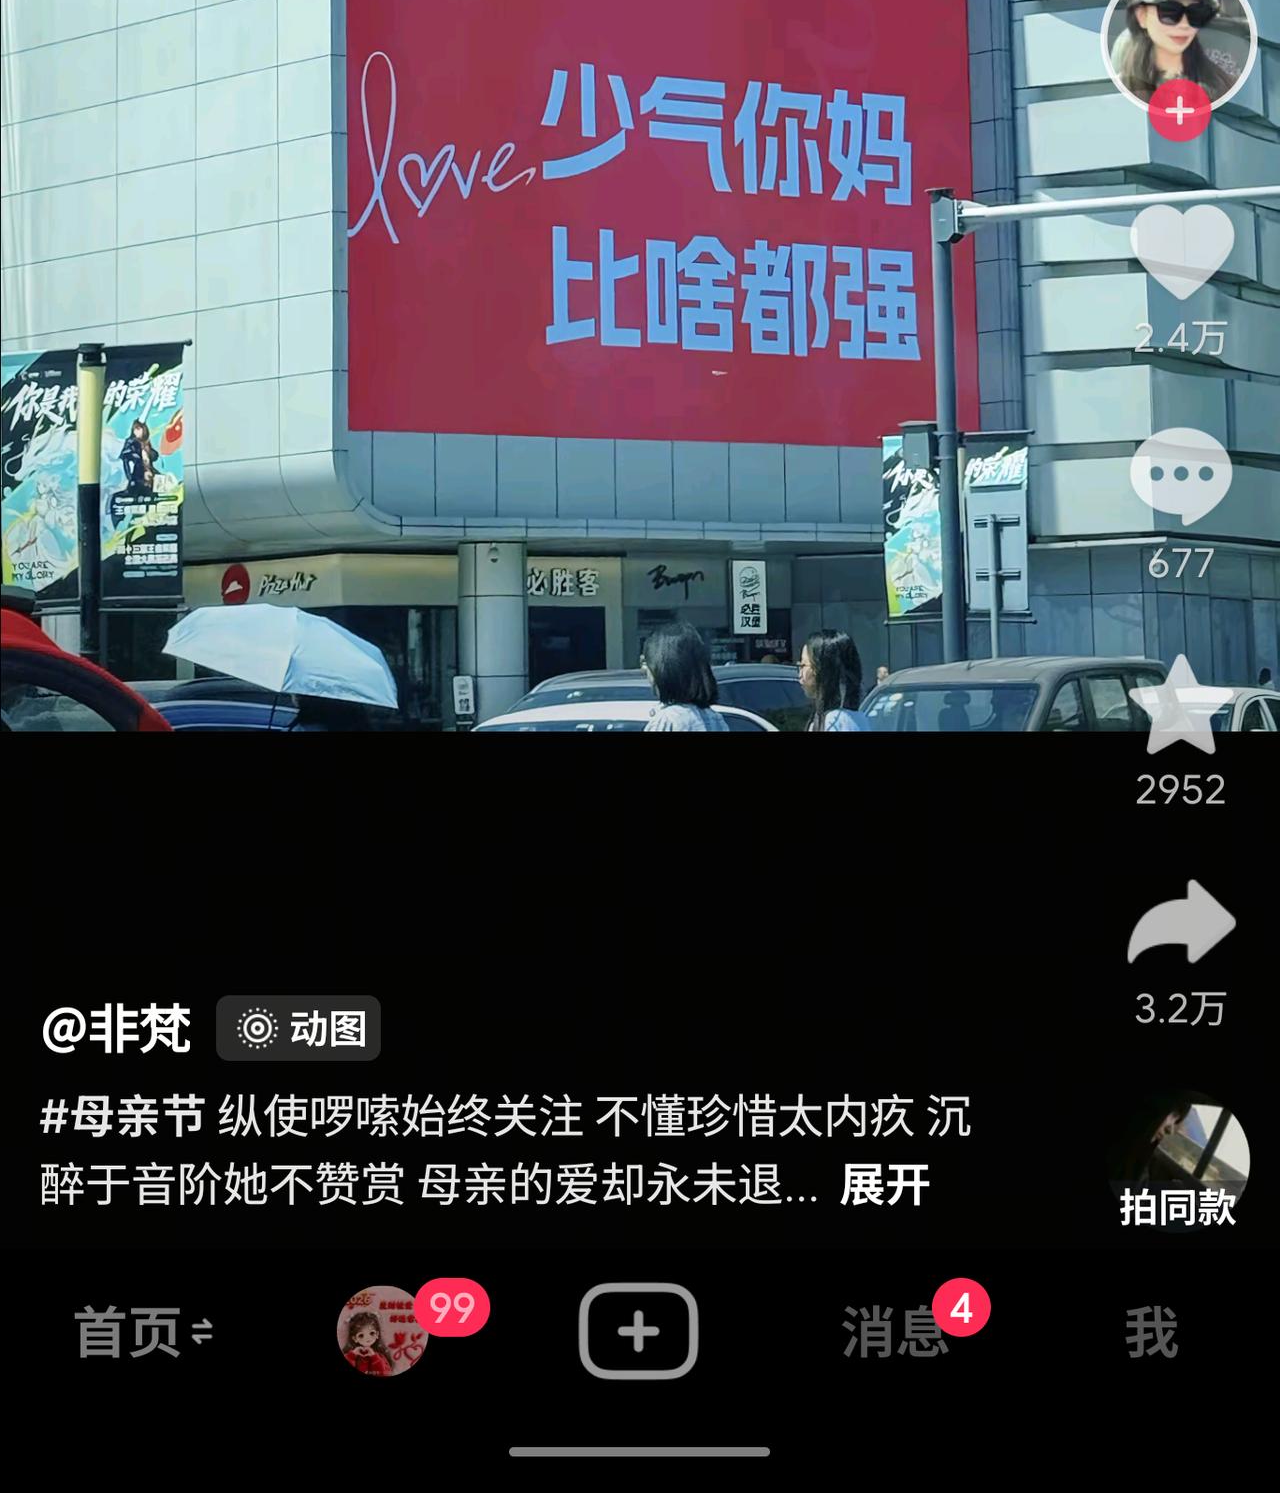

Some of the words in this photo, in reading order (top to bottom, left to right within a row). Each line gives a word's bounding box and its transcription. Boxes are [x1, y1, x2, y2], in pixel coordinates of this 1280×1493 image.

[540, 62, 913, 207] 少气你妈
[545, 225, 922, 361] 比啥都强
[526, 567, 600, 597] 必胜客
